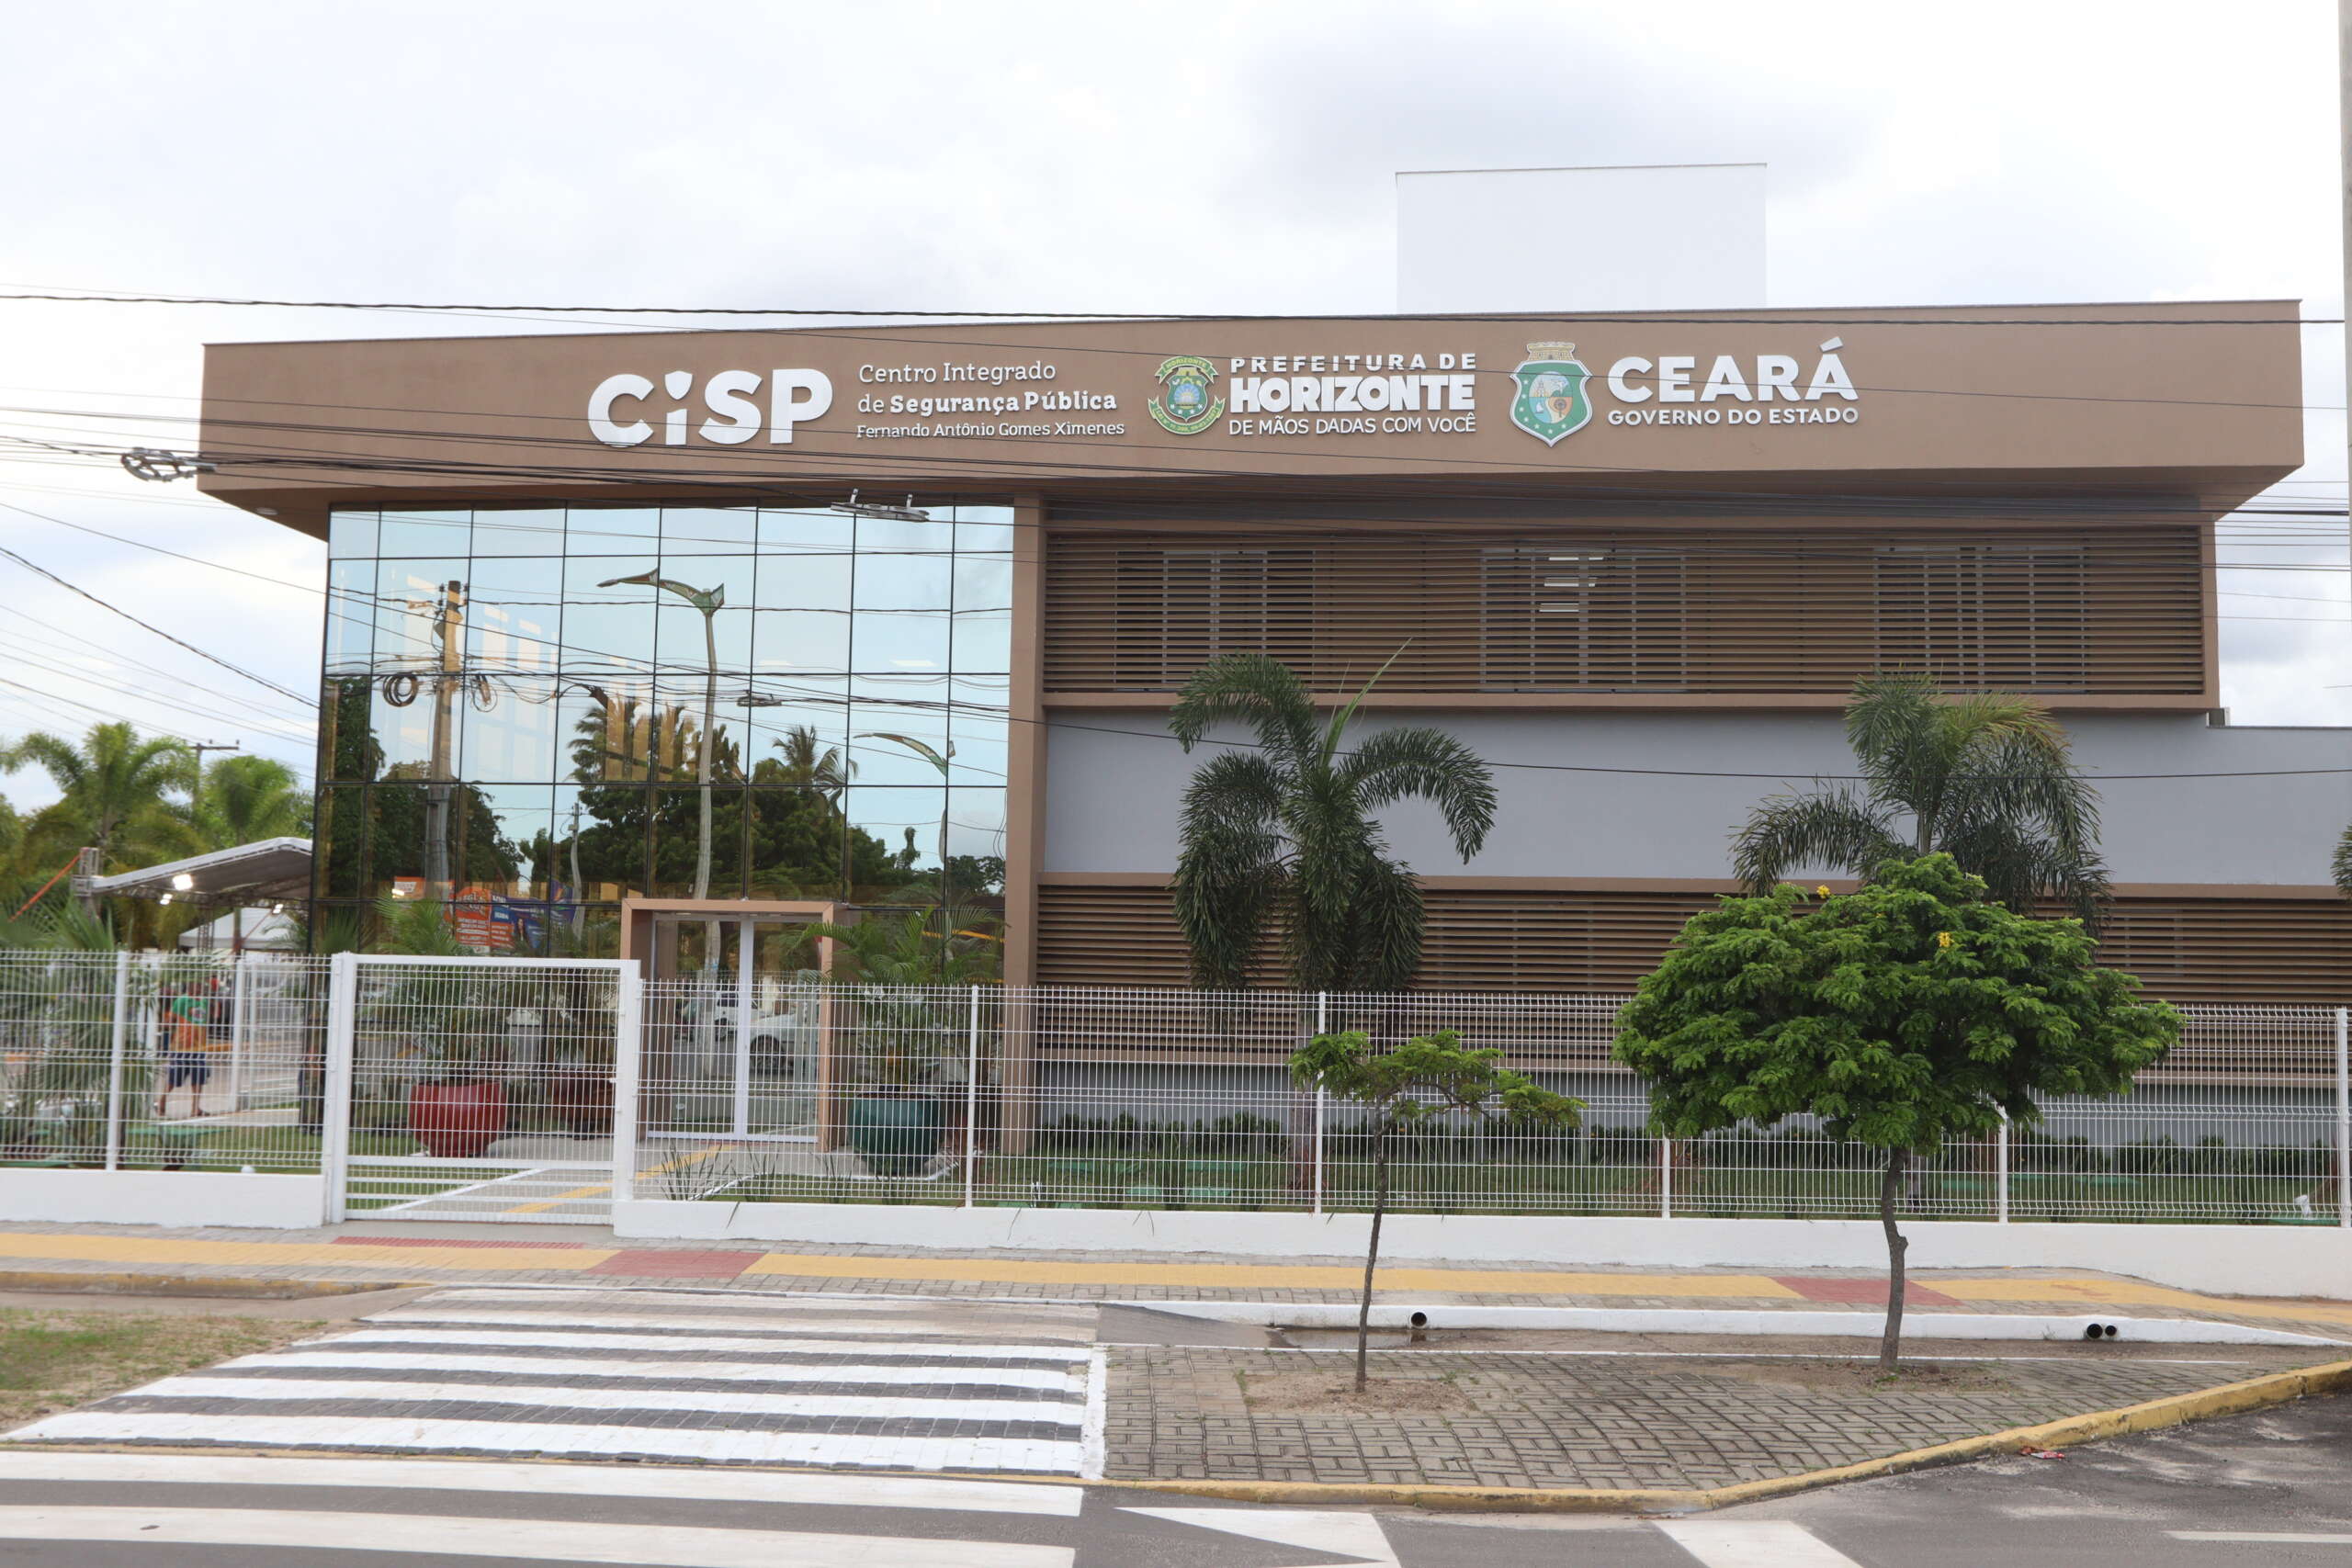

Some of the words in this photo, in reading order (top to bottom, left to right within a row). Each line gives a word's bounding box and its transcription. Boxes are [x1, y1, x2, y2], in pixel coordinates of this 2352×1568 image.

[859, 364, 937, 383] Centro
[943, 360, 1056, 386] Integrado
[1166, 356, 1206, 368] HORIZONTE
[1230, 353, 1427, 372] PREFEITURA
[1439, 353, 1476, 370] DE
[1607, 336, 1859, 402] CEARÁ
[857, 393, 885, 413] de
[889, 394, 1020, 417] Segurança
[1023, 389, 1117, 411] Pública
[1229, 374, 1476, 412] HORIZONTE
[1228, 419, 1253, 435] DE
[1259, 415, 1309, 434] MÃOS
[1316, 417, 1376, 434] DADAS
[1382, 416, 1422, 434] COM
[1427, 413, 1476, 433] VOCÊ
[1607, 408, 1721, 425] GOVERNO
[1727, 408, 1762, 424] DO
[1769, 407, 1859, 424] ESTADO
[856, 423, 930, 438] Fernando
[933, 422, 995, 436] Antônio
[999, 423, 1051, 436] Gomes
[1054, 421, 1125, 435] Ximenes
